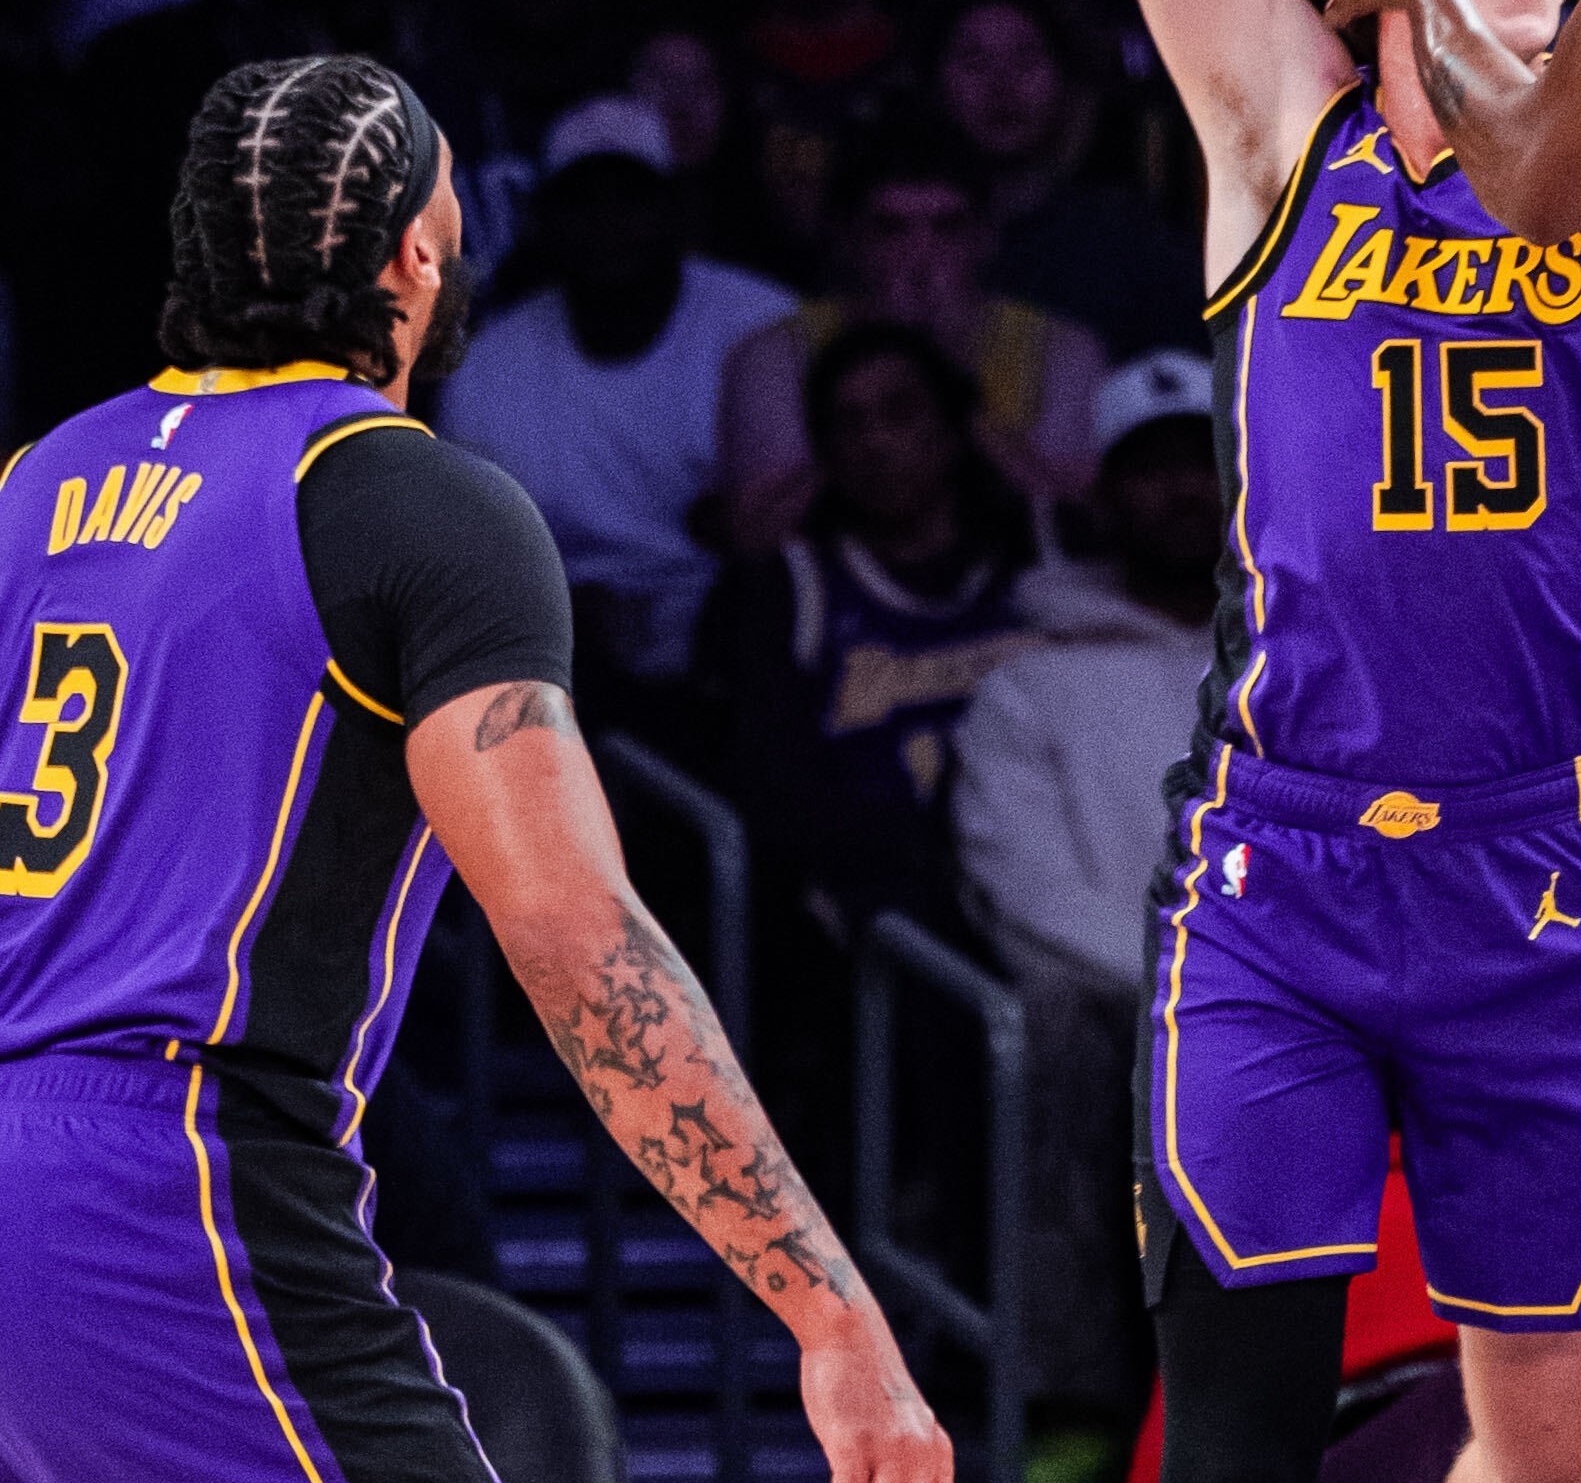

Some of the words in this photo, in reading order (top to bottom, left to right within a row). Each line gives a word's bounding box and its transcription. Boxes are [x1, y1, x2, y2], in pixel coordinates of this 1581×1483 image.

[47, 461, 203, 556] DAVIS
[1371, 338, 1548, 533] 15
[0, 622, 129, 899] 3
